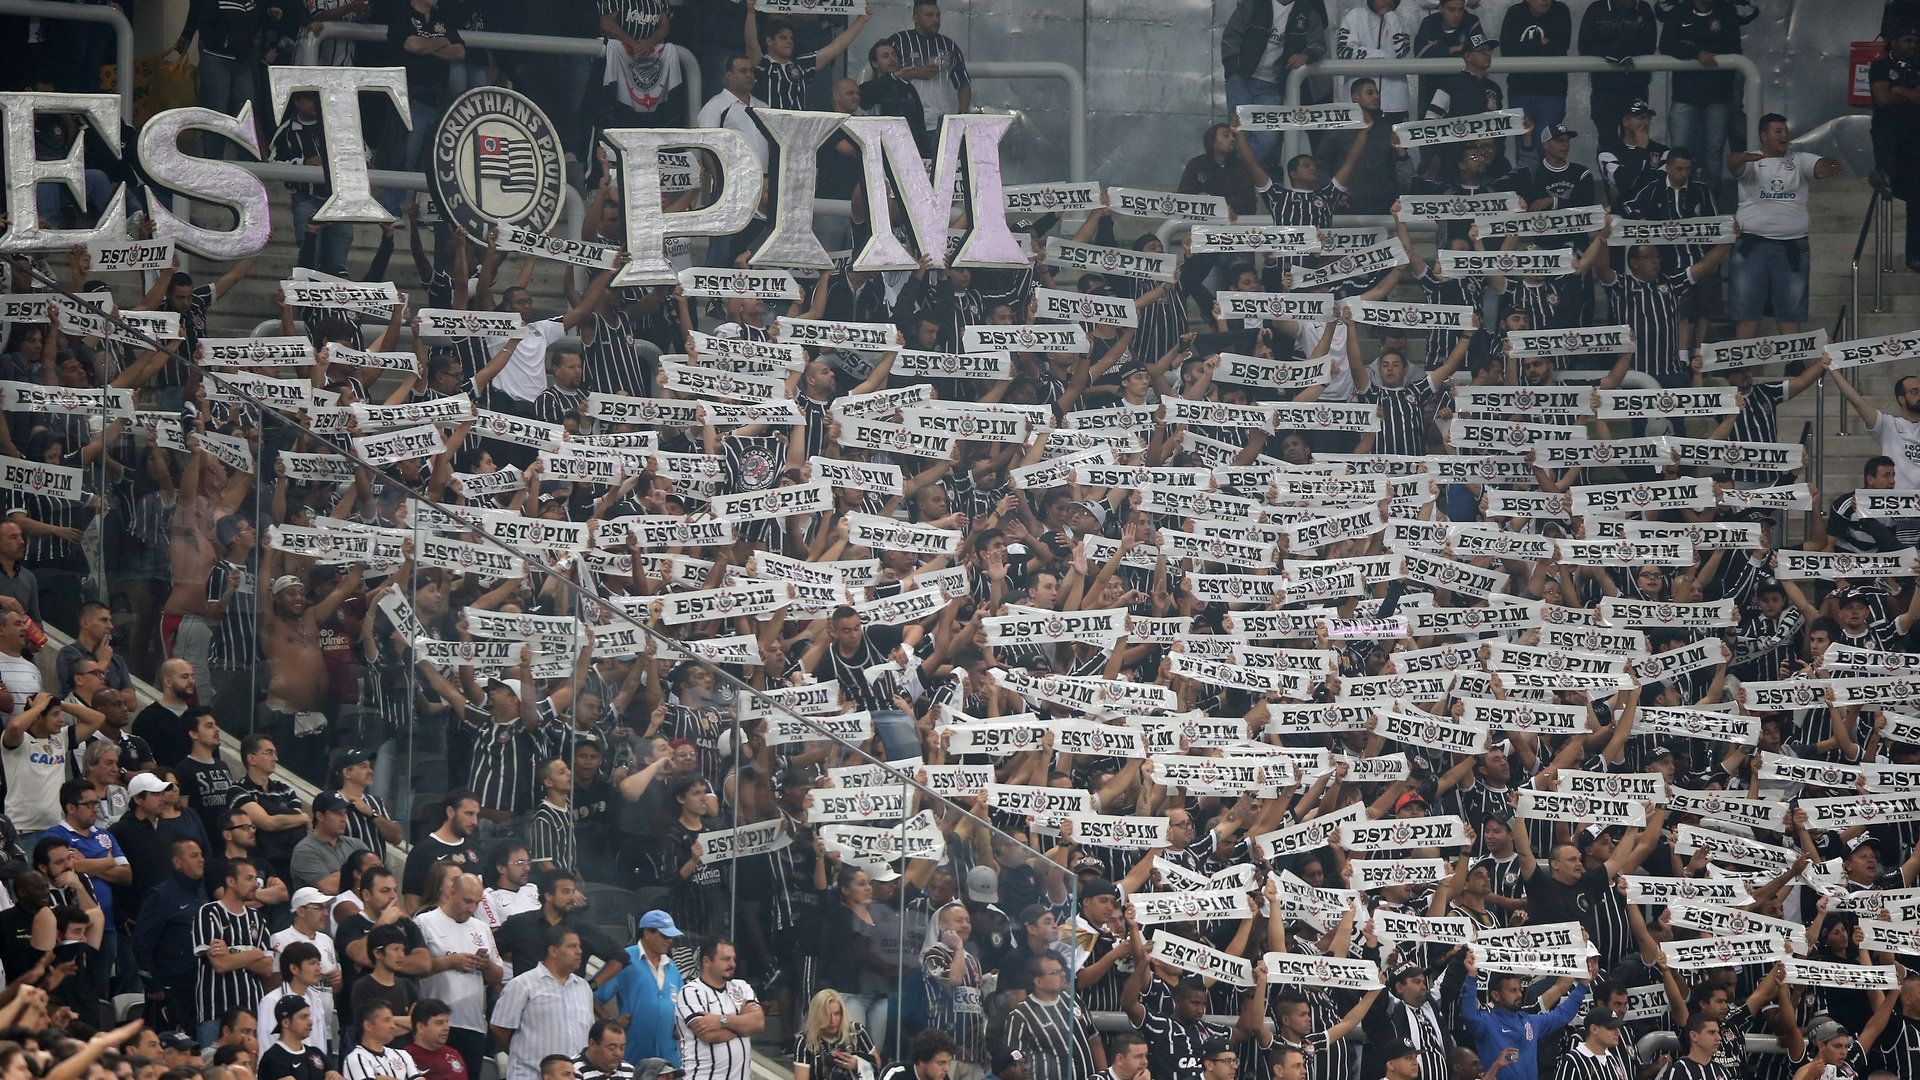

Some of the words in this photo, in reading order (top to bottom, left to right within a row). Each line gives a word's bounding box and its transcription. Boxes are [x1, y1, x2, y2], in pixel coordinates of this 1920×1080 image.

[529, 134, 560, 230] PAULISTA
[871, 484, 890, 492] FIEL
[1213, 514, 1240, 522] FIEL
[1458, 585, 1483, 596] FIEL
[1442, 743, 1466, 752] FIEL
